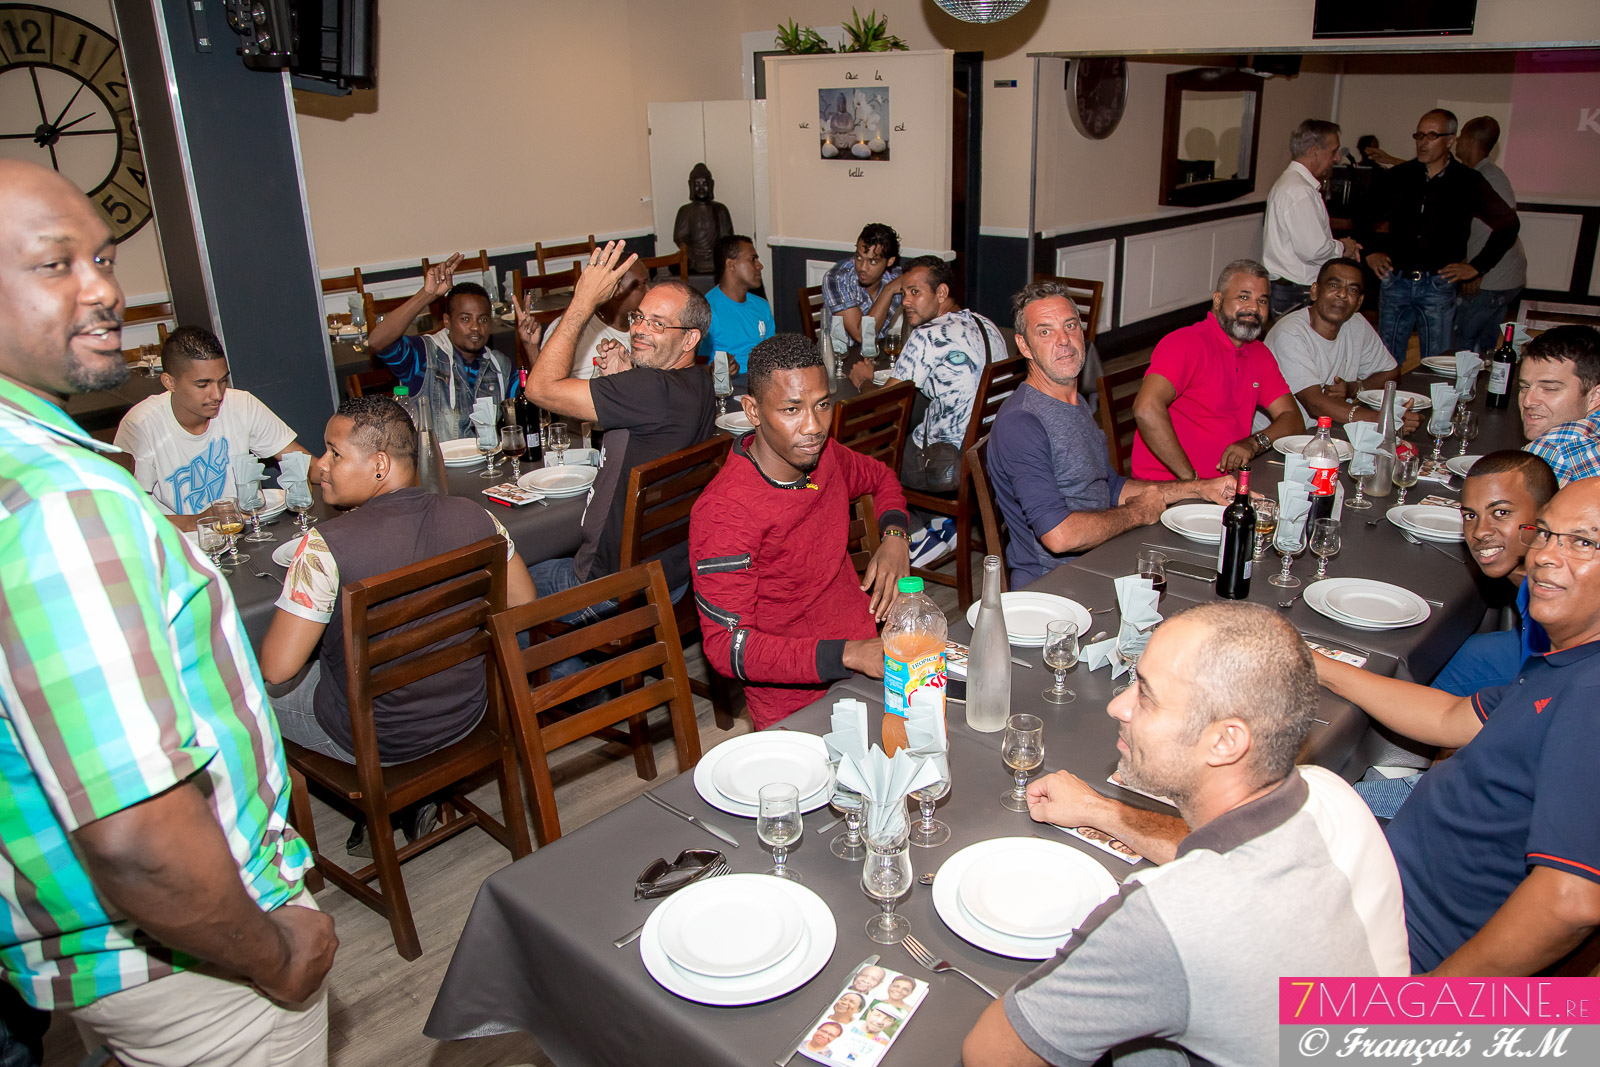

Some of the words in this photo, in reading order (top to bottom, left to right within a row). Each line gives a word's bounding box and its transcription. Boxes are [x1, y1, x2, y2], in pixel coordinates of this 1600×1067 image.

[3, 19, 46, 55] 12
[70, 34, 88, 65] 1
[845, 71, 859, 80] Que
[848, 167, 864, 178] belle
[101, 194, 132, 224] 5
